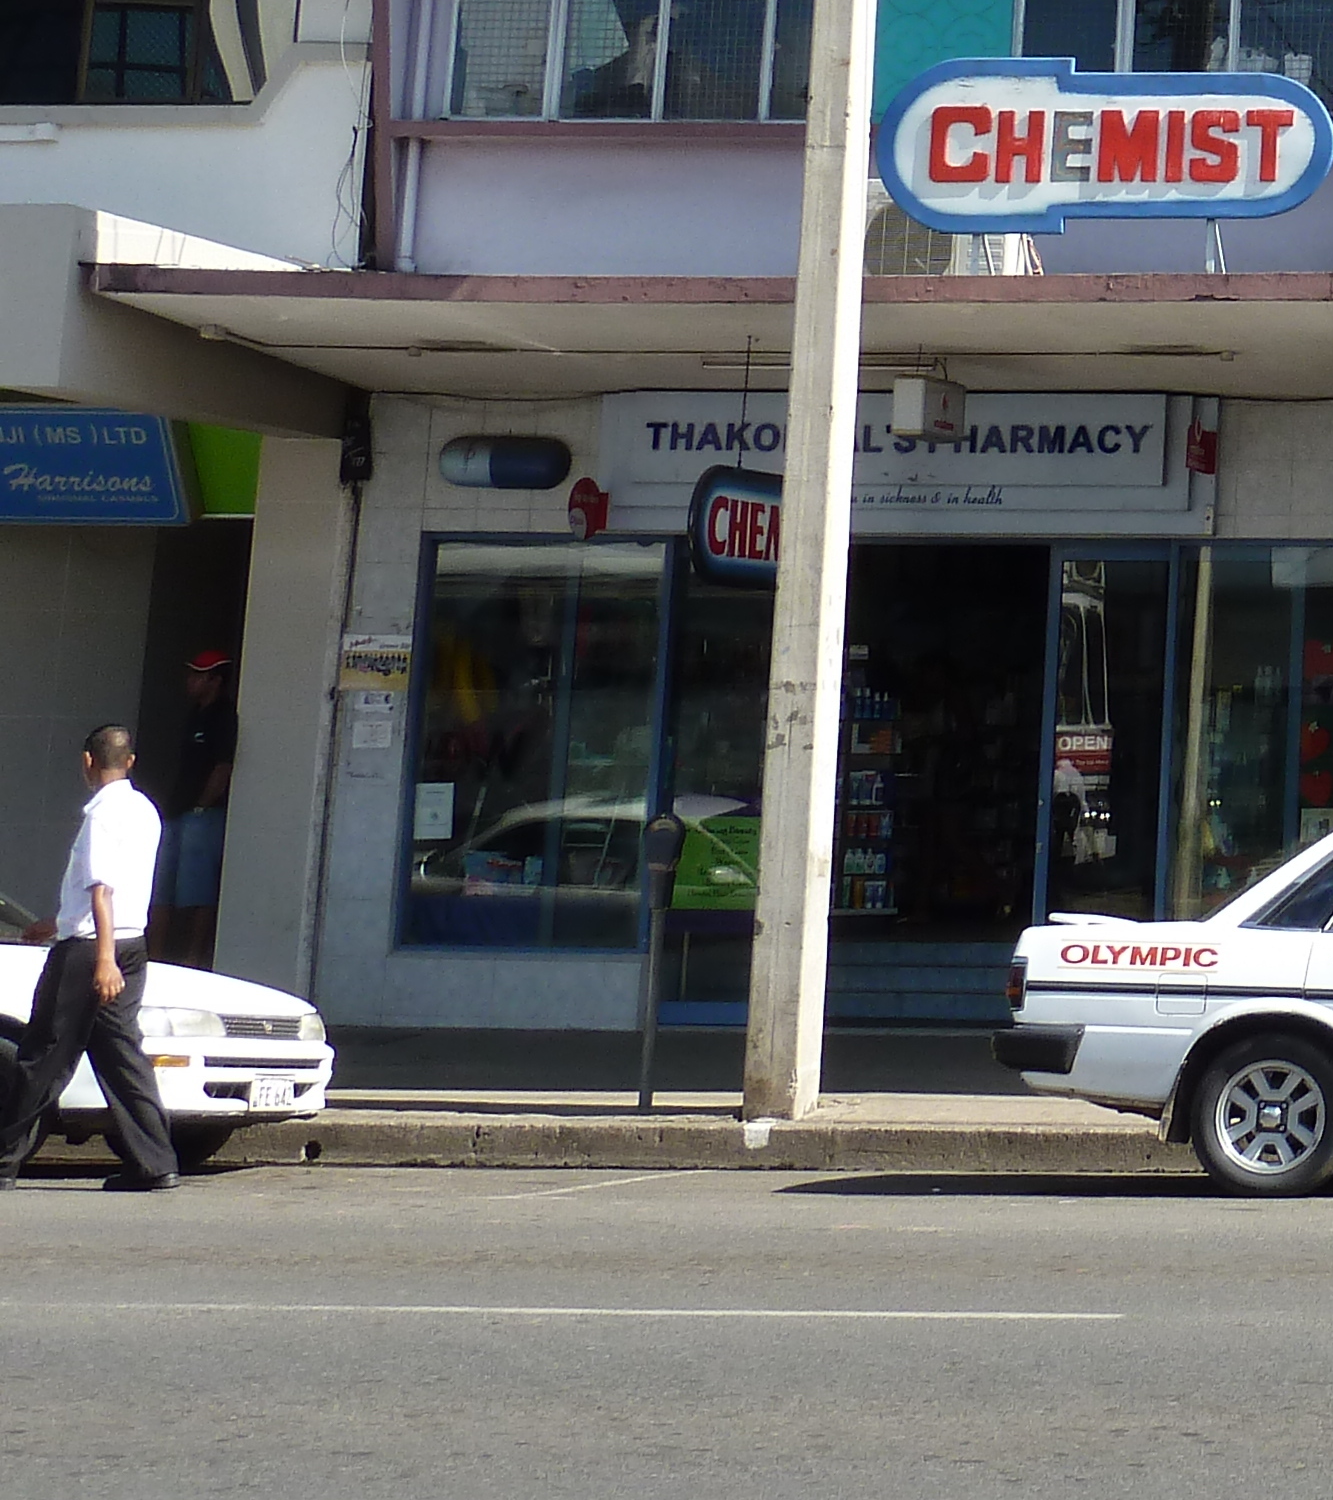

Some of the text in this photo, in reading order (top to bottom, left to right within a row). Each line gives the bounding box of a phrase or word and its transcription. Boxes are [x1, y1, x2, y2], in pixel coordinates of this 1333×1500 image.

[929, 104, 1294, 184] CHEMIST
[3, 463, 153, 491] Harrisons
[963, 484, 1003, 505] health
[1058, 735, 1108, 751] OPEN
[1060, 944, 1219, 967] OLYMPIC
